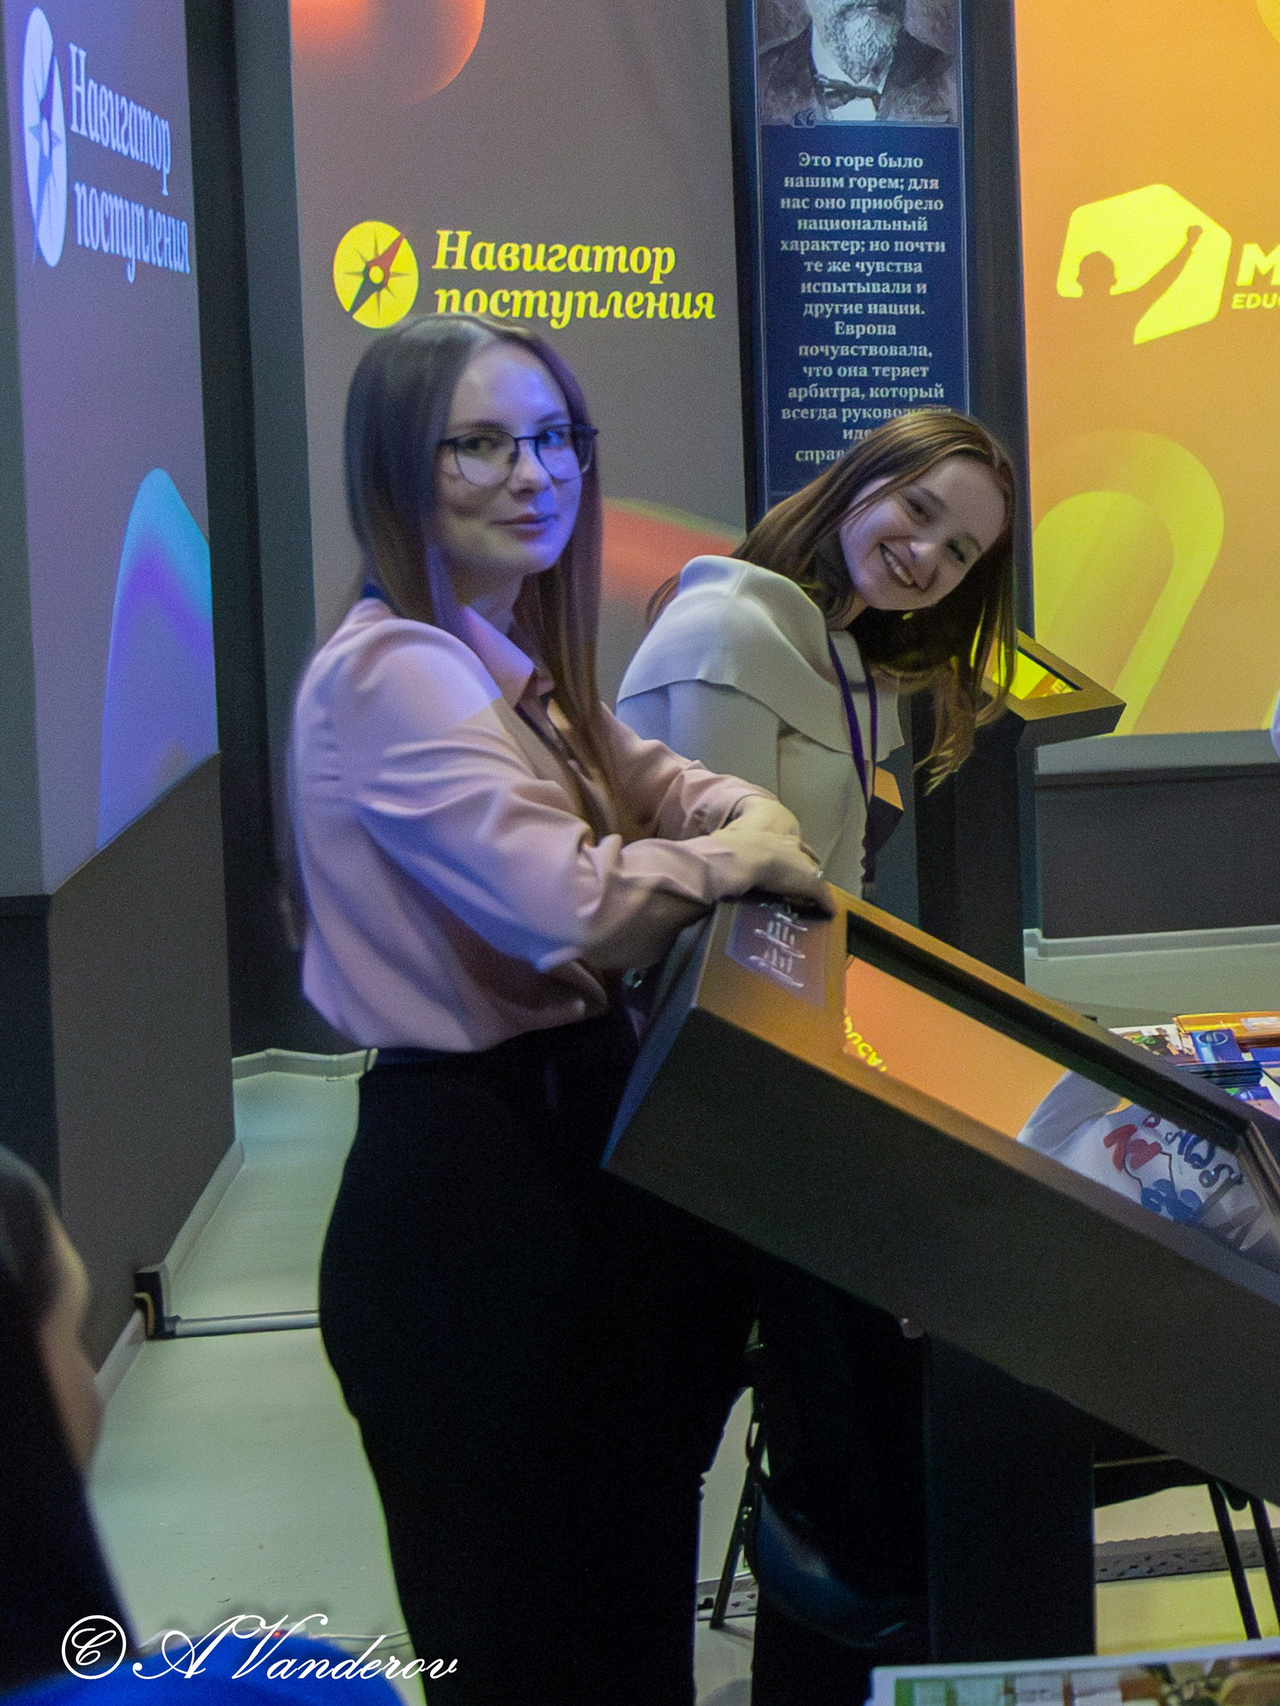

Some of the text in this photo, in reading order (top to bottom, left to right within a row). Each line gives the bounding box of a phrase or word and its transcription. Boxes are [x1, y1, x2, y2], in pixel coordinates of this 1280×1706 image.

[68, 42, 172, 196] Навигатор
[799, 152, 923, 171] Это горе было
[784, 176, 939, 192] нашим горем; для
[780, 195, 944, 213] нас оно приобрело
[74, 181, 190, 284] поступления
[797, 217, 928, 232] национальный
[780, 240, 946, 255] характер; но почти
[432, 230, 676, 284] Навигатор
[804, 261, 923, 276] те же чувства
[801, 282, 928, 294] испытывали и
[434, 288, 716, 329] поступления
[803, 303, 926, 318] другие нации.
[834, 321, 897, 339] Европа
[798, 345, 933, 360] почувствовала,
[803, 366, 930, 381] что она теряет
[788, 383, 944, 402] арбитра, который
[781, 408, 838, 420] всегда
